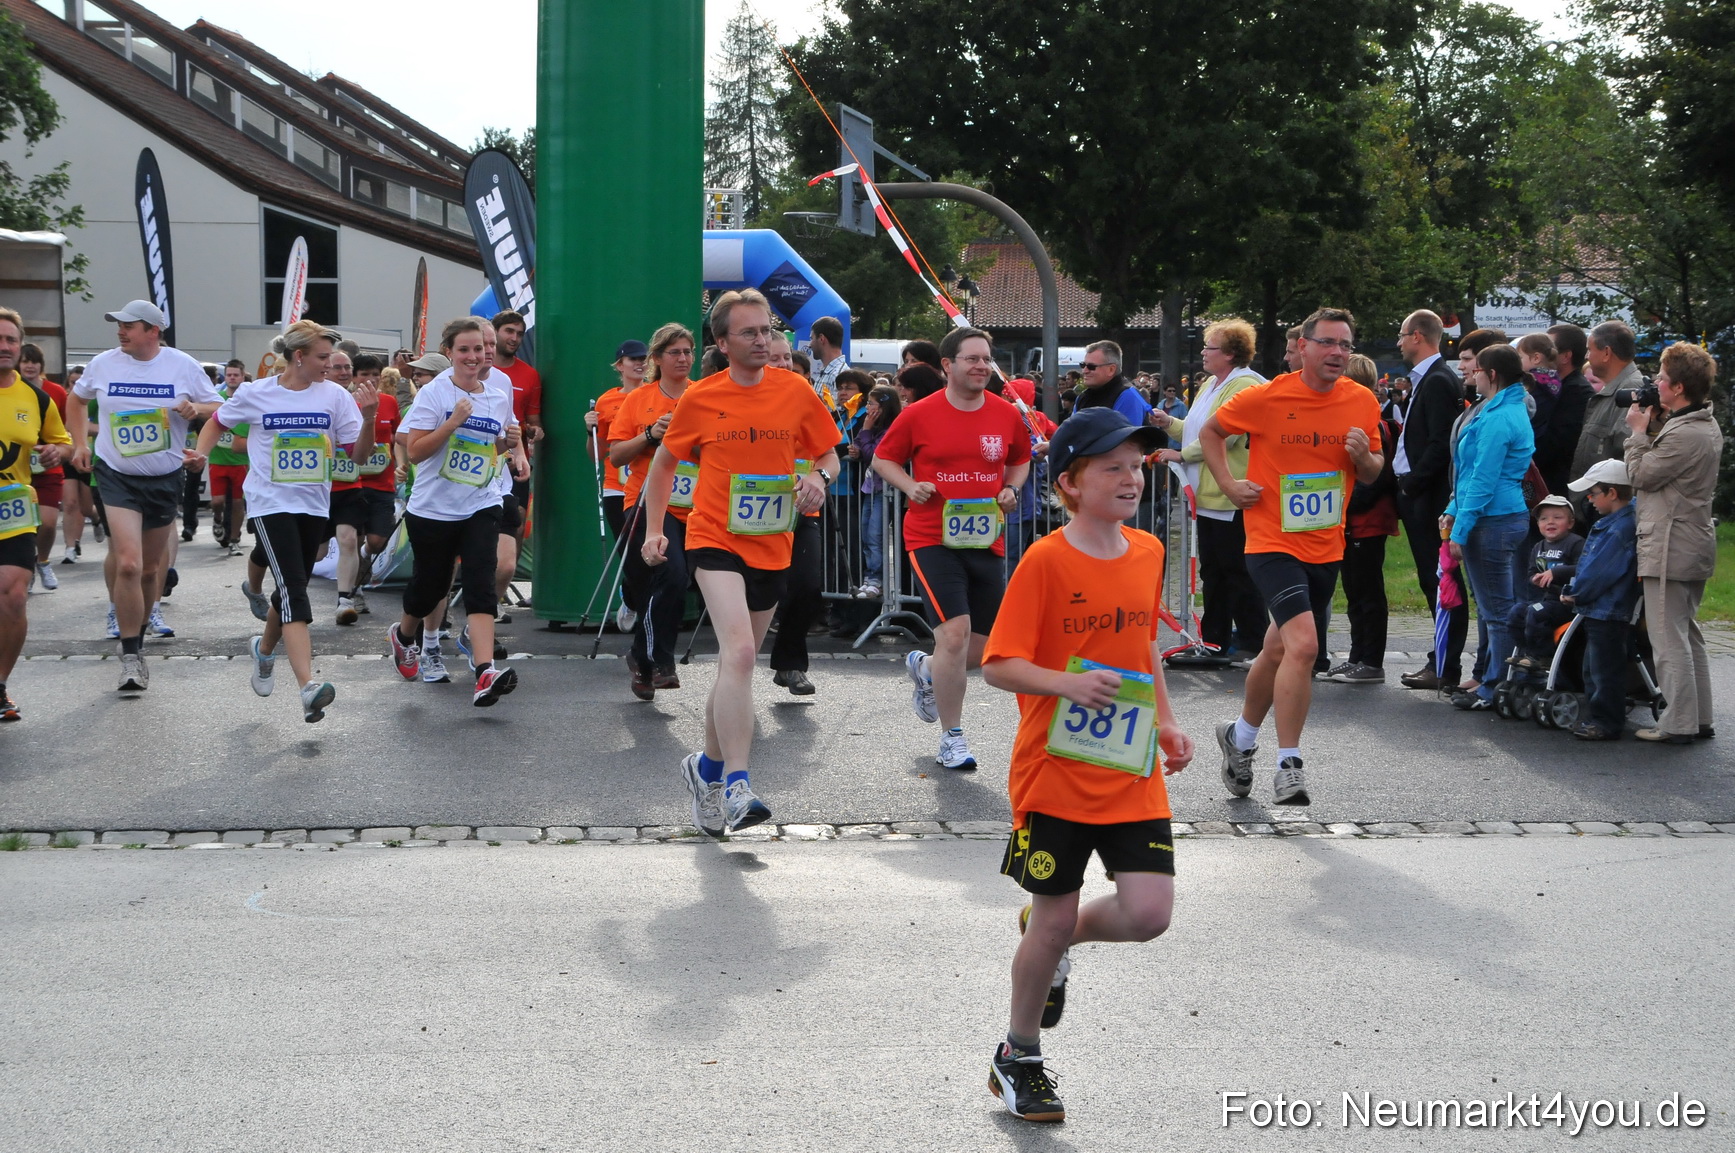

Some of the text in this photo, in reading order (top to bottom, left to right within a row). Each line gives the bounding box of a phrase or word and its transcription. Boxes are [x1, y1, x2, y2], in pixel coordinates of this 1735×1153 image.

[117, 386, 171, 395] STAEDTLER
[17, 412, 28, 422] FC
[273, 417, 328, 426] STAEDTLER
[465, 418, 500, 432] AEDTLER
[117, 424, 159, 445] 903
[716, 429, 790, 442] EURO POLES
[1280, 434, 1347, 445] EURO POLE
[278, 450, 318, 470] 883
[449, 450, 485, 475] 882
[737, 495, 783, 520] 571
[1288, 491, 1333, 517] 601
[948, 515, 990, 537] 943
[1063, 611, 1151, 634] EURO POL
[1064, 702, 1140, 746] 581
[1069, 734, 1106, 751] Frederik
[1032, 854, 1052, 872] BVB
